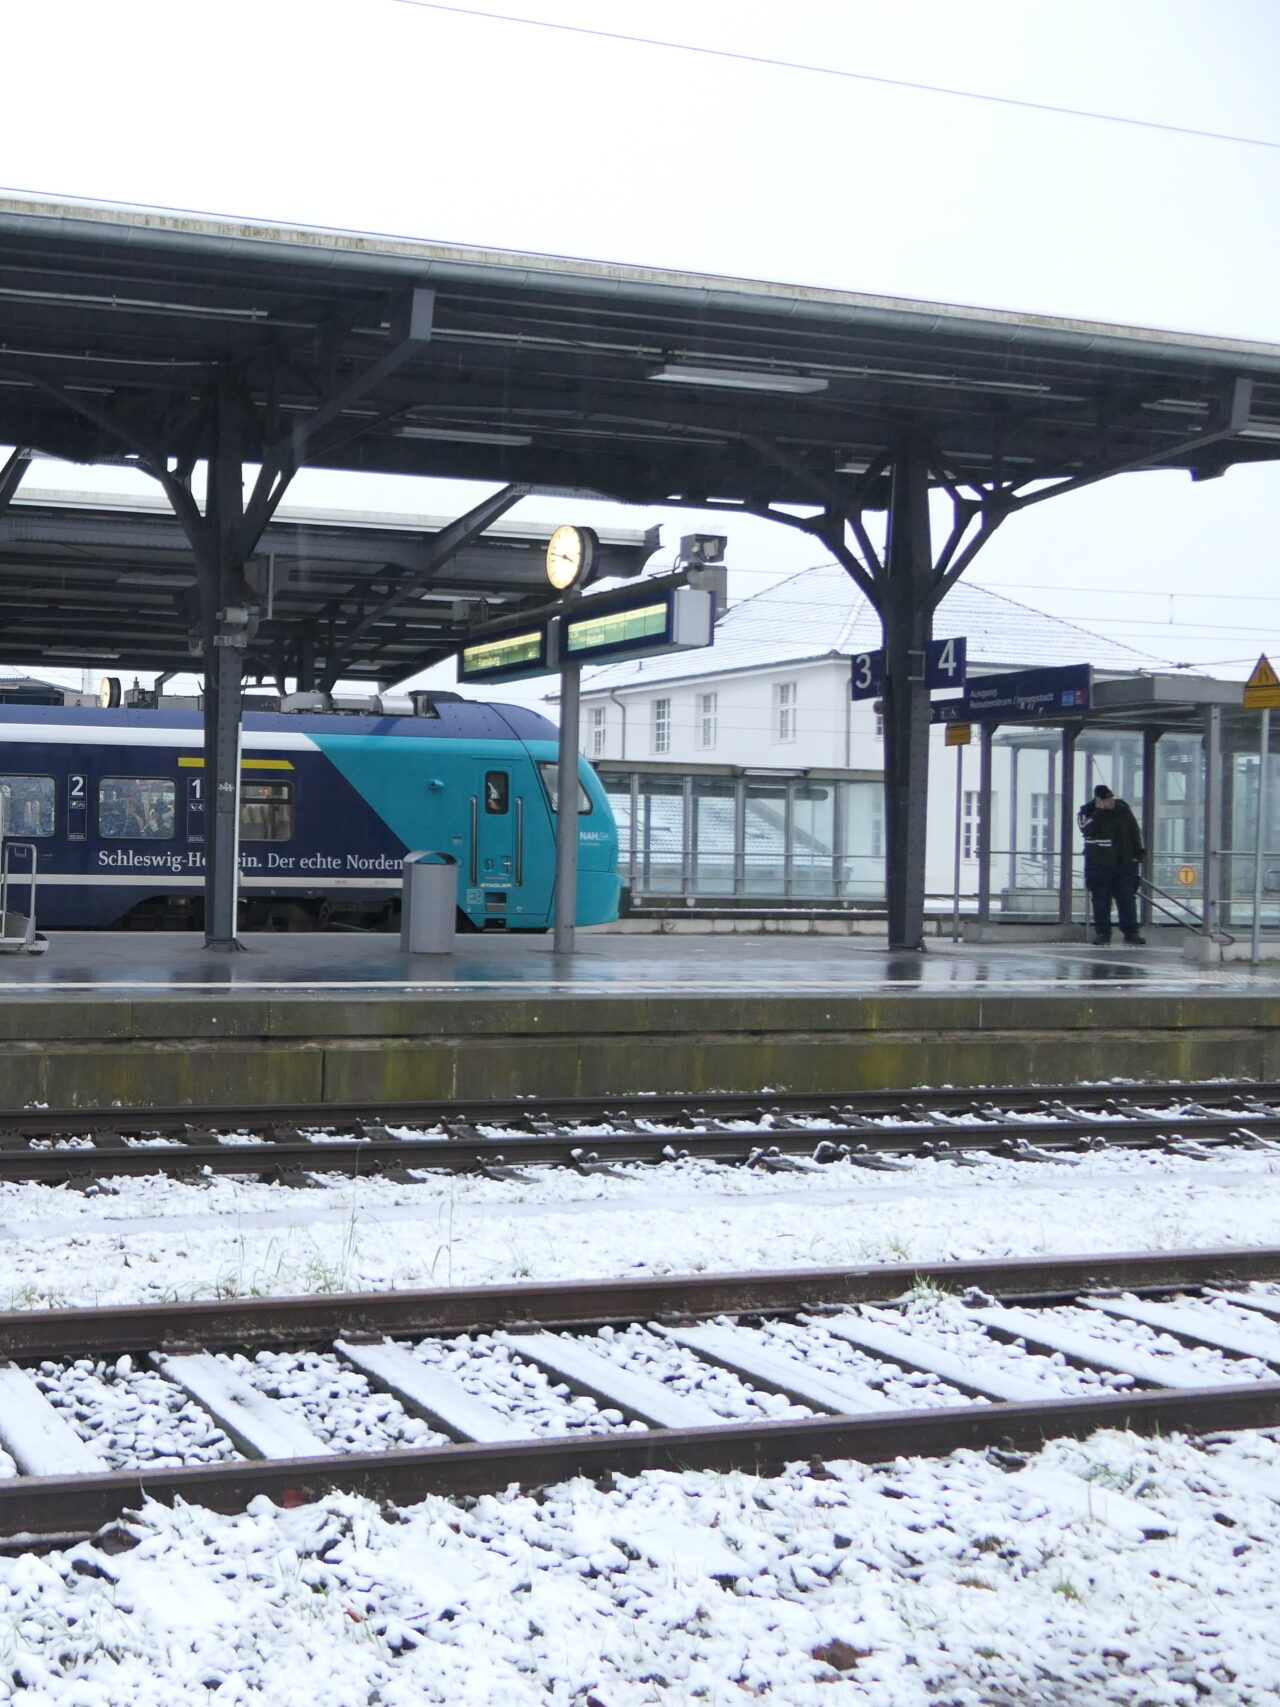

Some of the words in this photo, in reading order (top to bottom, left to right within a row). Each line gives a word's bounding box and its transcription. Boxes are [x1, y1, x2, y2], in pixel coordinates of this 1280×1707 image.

[937, 639, 957, 677] 4
[855, 654, 872, 689] 3
[71, 776, 84, 796] 2
[191, 779, 201, 799] 1
[579, 832, 609, 841] NAH.SH
[98, 850, 262, 872] Schleswig-Hein.
[267, 853, 295, 868] Der
[300, 853, 342, 869] echte
[346, 854, 403, 870] Norden
